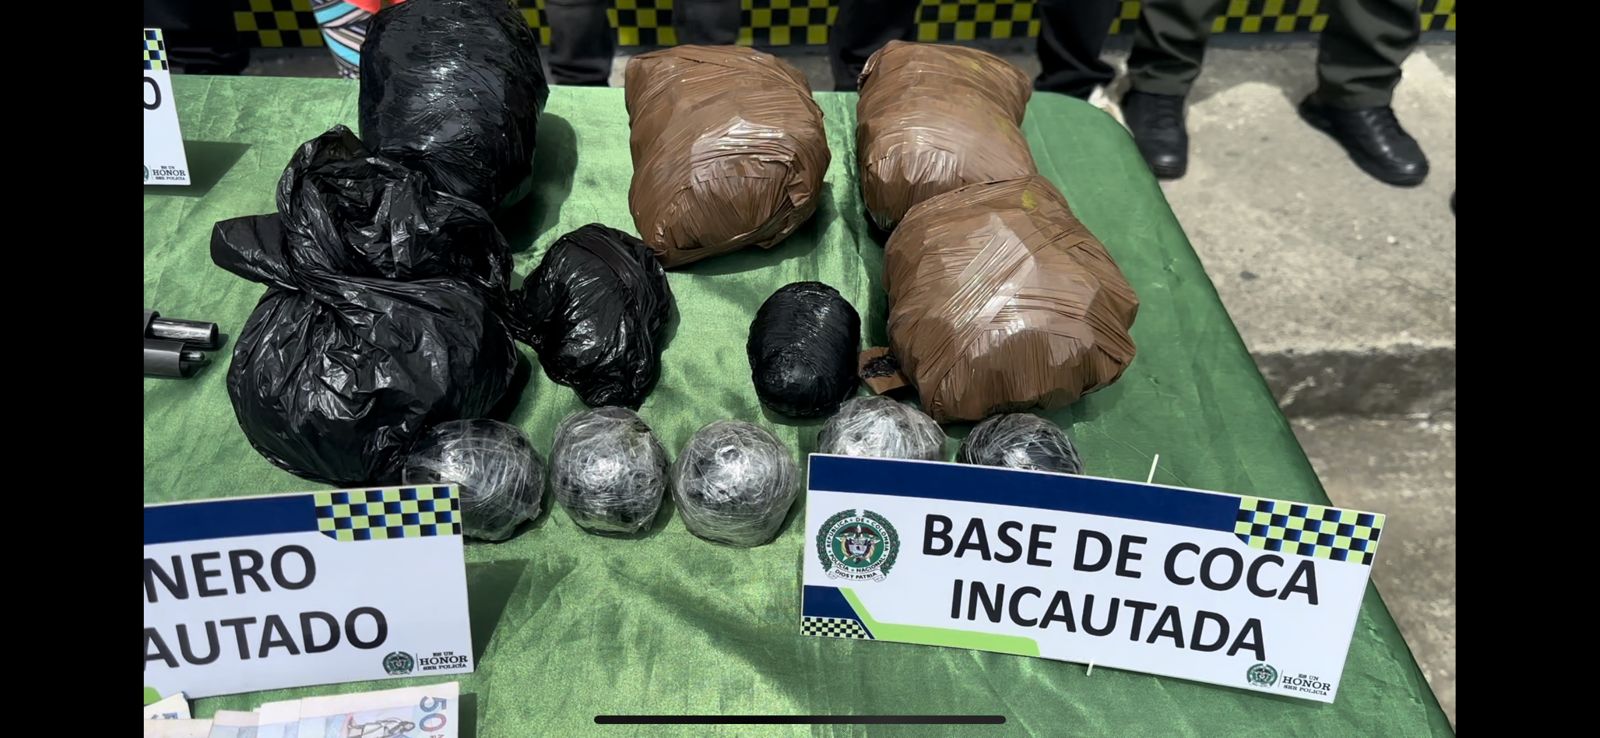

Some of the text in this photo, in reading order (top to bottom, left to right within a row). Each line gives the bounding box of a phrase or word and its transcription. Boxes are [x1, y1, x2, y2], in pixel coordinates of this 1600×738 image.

[871, 521, 890, 552] COLOMBIA
[144, 544, 317, 603] NERO
[835, 569, 849, 578] DIOS
[855, 571, 877, 580] PATRIA
[855, 557, 887, 573] NACIONAL
[921, 513, 1321, 606] BASE DE COCA
[950, 578, 1268, 662] INCAUTADA
[144, 606, 389, 671] AUTADO
[420, 655, 468, 665] HONOR
[1282, 676, 1331, 691] HONOR
[419, 695, 447, 732] 50
